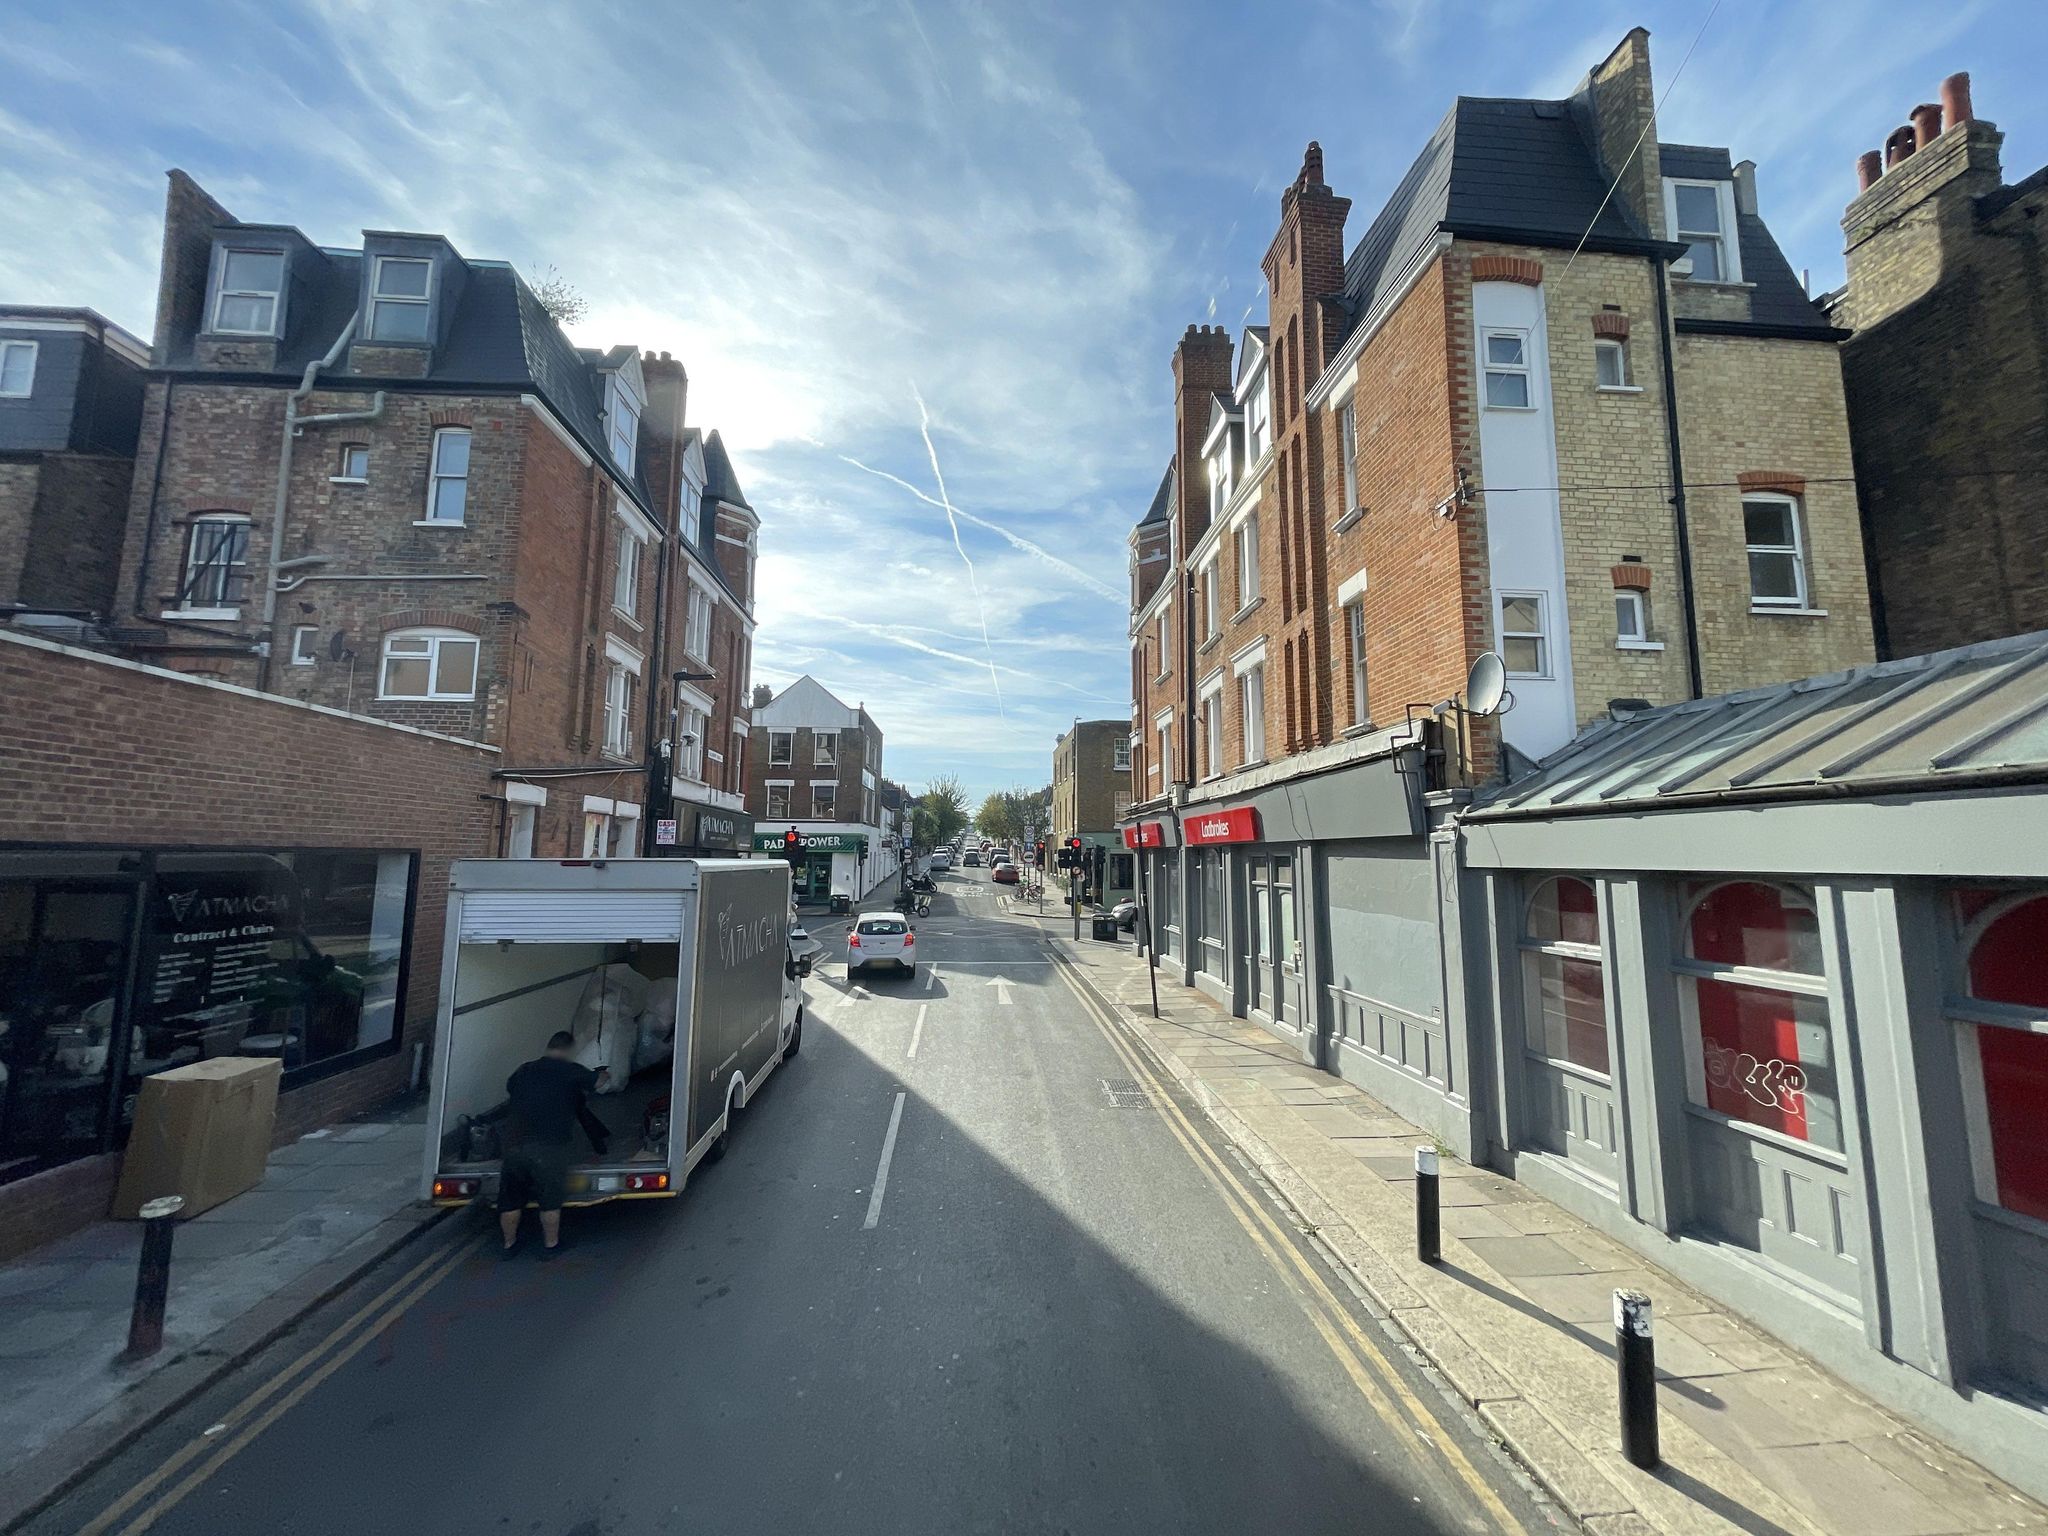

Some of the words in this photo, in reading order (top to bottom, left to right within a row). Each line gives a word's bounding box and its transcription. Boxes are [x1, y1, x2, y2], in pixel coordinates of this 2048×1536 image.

[1201, 819, 1229, 838] Ladbrokes
[173, 929, 227, 944] Contract
[229, 927, 238, 937] &
[242, 924, 275, 936] Chairs
[724, 913, 778, 970] ATMACHA
